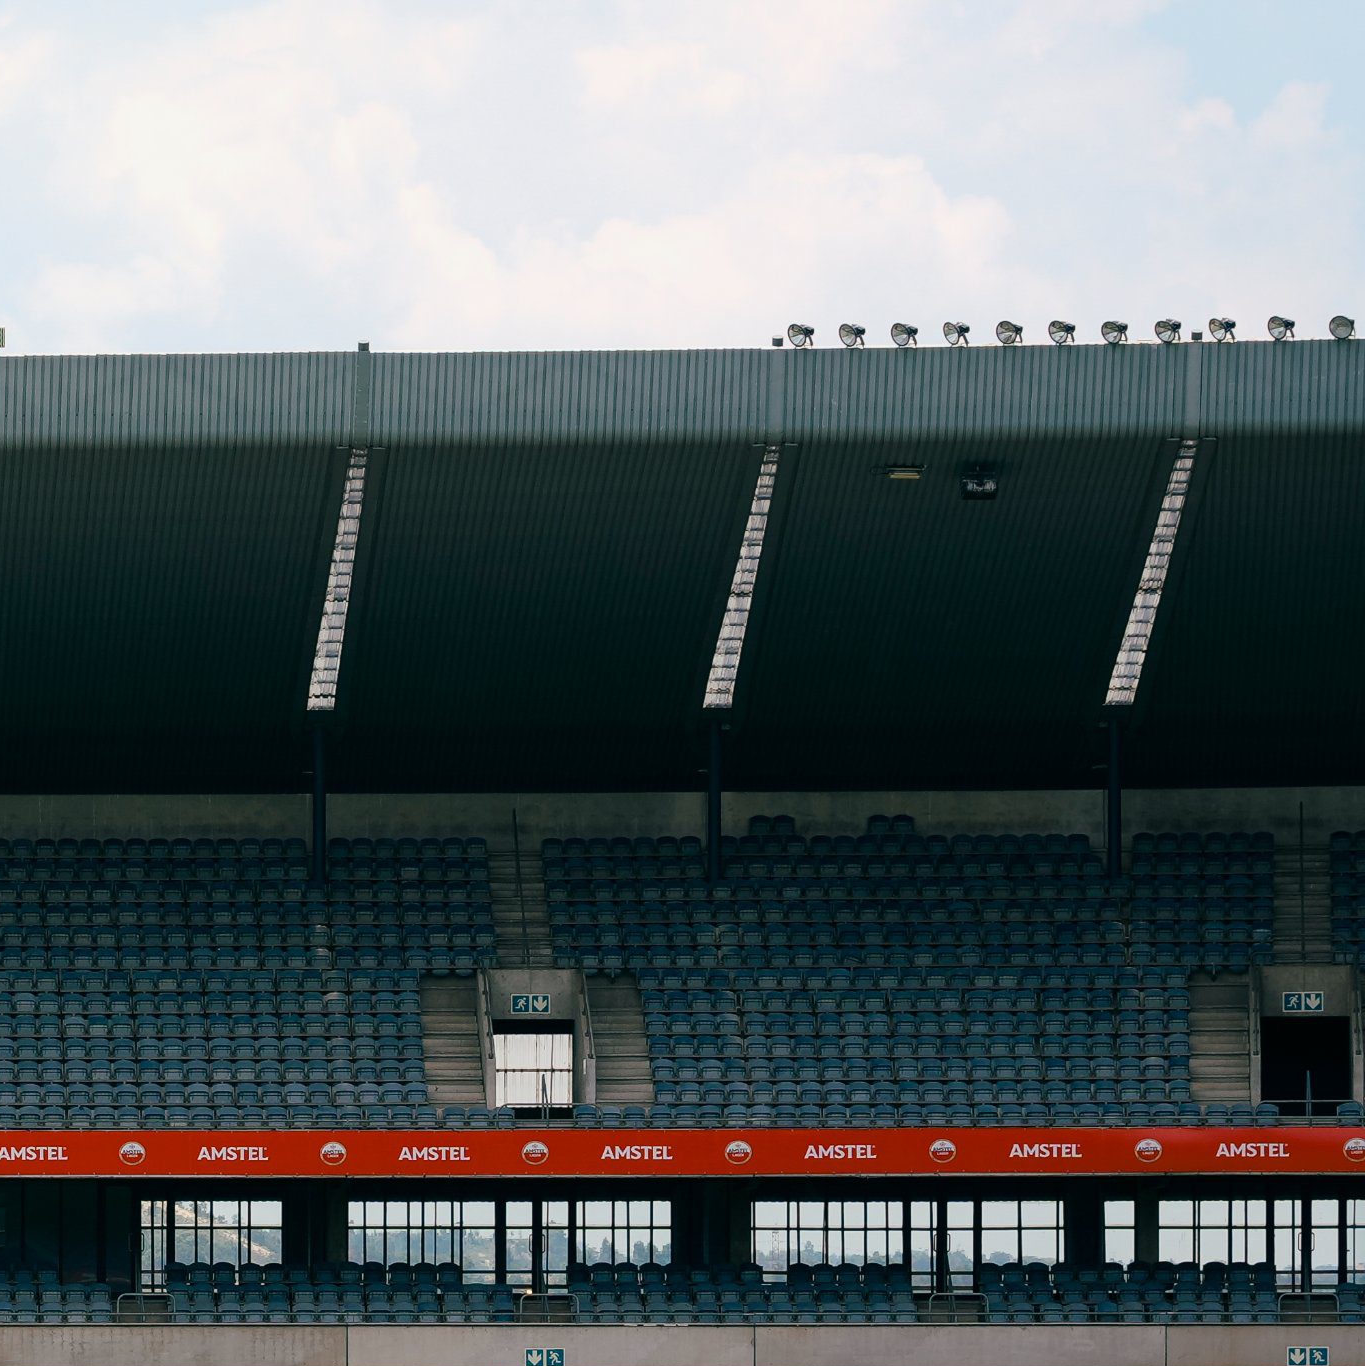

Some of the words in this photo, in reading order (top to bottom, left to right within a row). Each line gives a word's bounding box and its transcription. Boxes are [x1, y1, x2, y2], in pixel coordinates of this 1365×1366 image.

[198, 1147, 269, 1160] AMSTEL
[399, 1147, 470, 1160] AMSTEL
[601, 1146, 672, 1159] AMSTEL
[805, 1145, 876, 1158] AMSTEL
[1010, 1144, 1081, 1157] AMSTEL
[1216, 1144, 1290, 1157] AMSTEL
